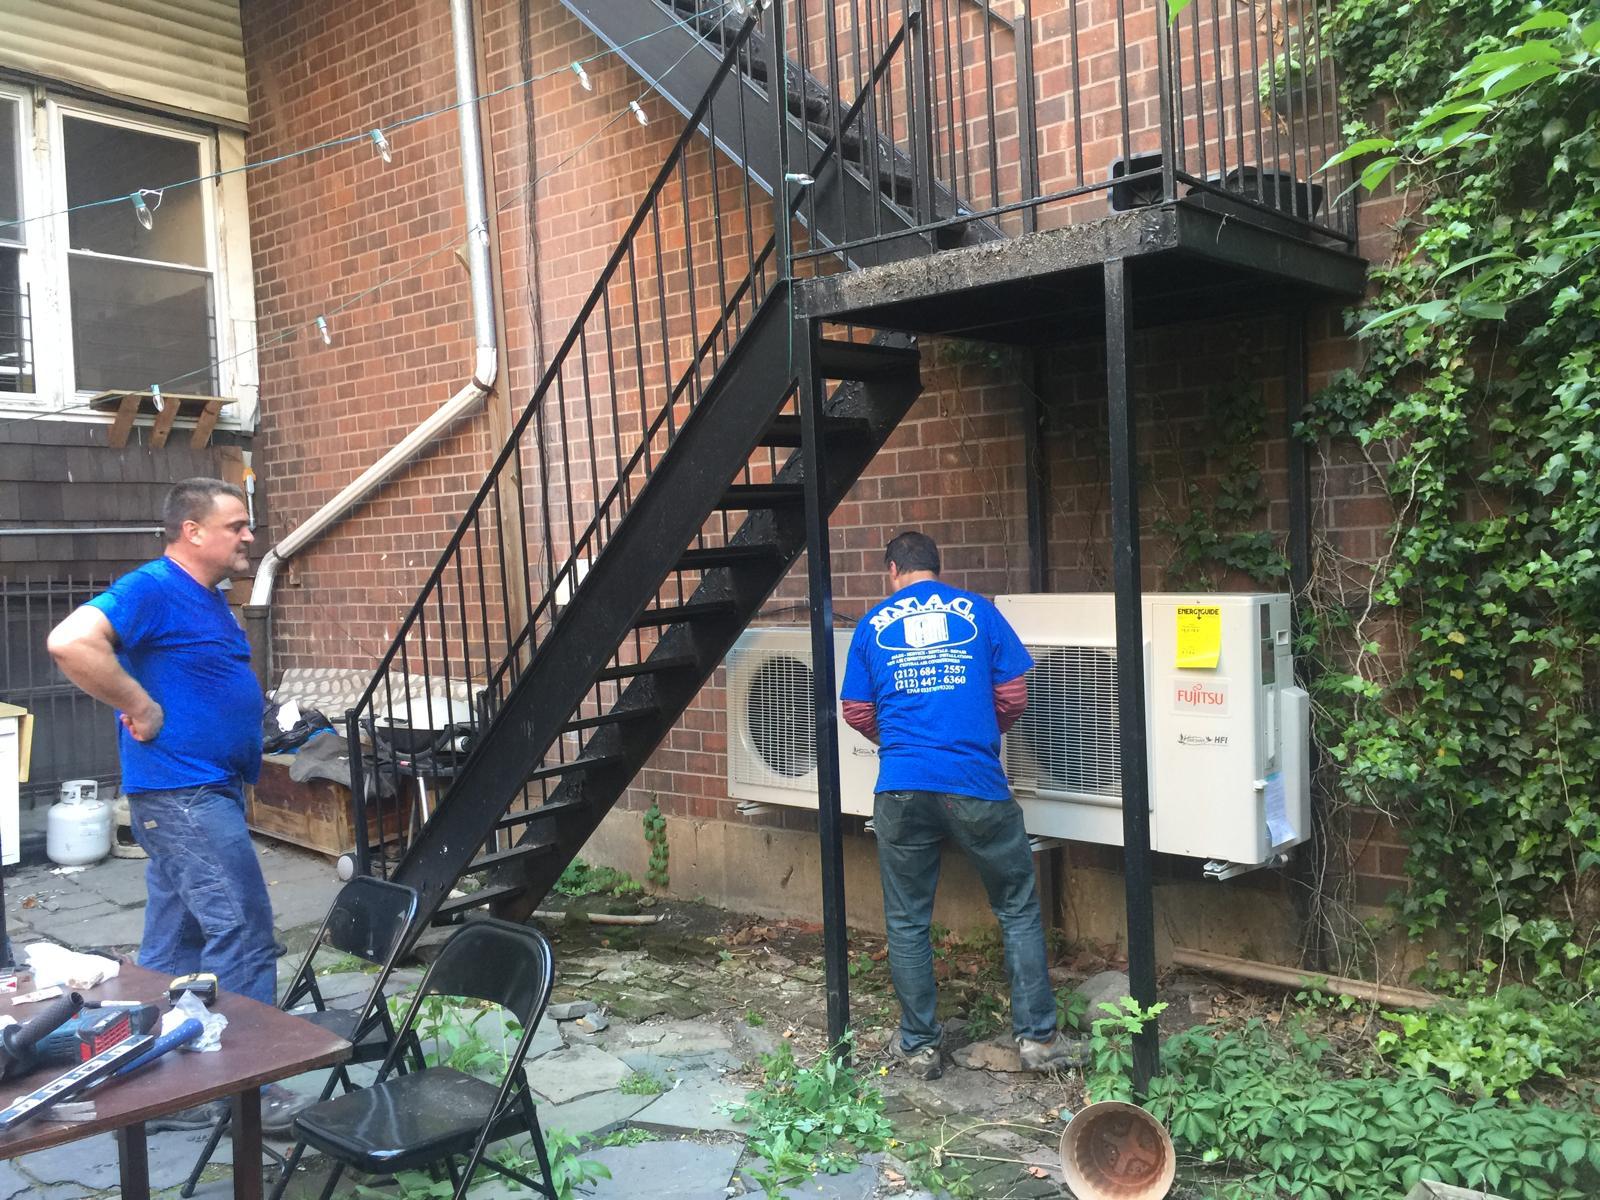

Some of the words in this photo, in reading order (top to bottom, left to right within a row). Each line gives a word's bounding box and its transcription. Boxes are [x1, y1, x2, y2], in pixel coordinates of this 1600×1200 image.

[894, 668, 918, 680] (212)
[919, 666, 936, 676] 684
[943, 664, 966, 674] 2557
[895, 679, 919, 691] (212)
[920, 677, 937, 687] 447
[943, 675, 967, 685] 6360
[1177, 684, 1224, 706] FUJITSU
